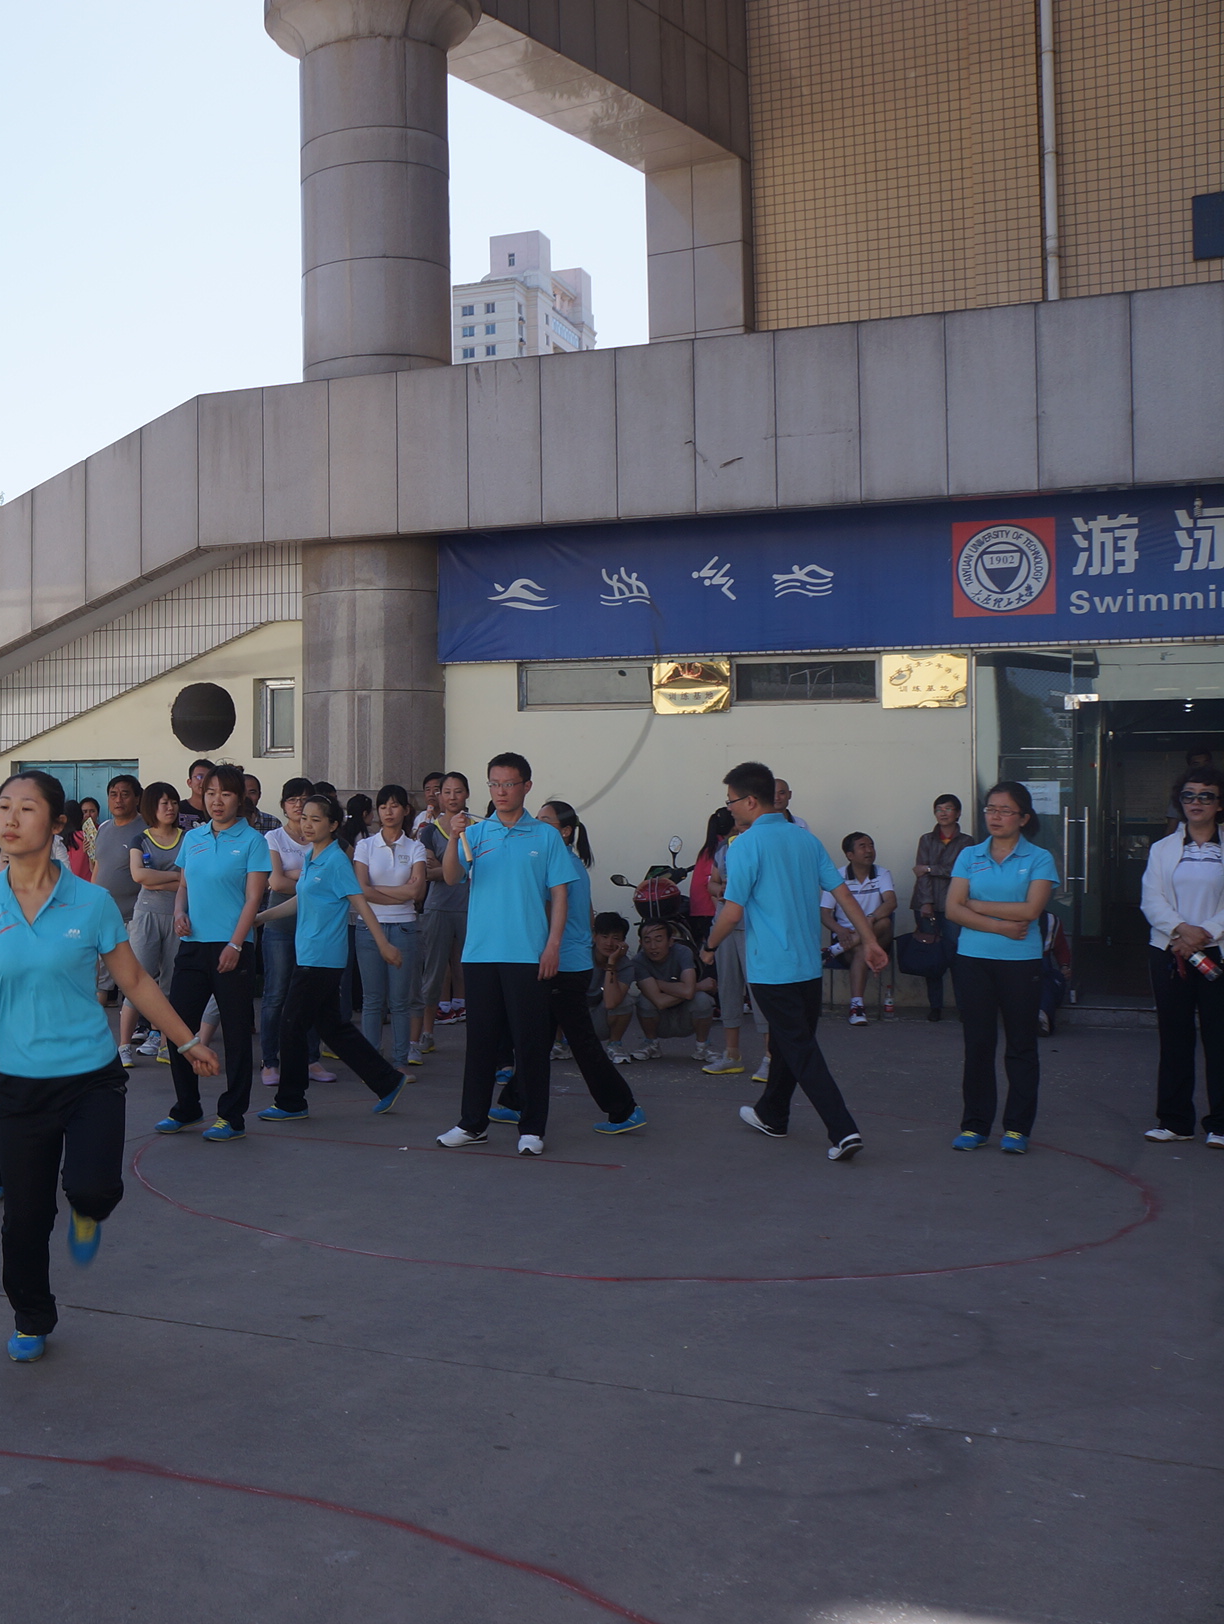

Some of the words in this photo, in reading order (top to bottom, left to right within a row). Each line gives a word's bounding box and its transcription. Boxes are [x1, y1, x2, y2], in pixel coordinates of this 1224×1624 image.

[961, 552, 974, 587] TAIYUAN
[968, 529, 1011, 553] UNIVERSITY
[1012, 531, 1024, 541] OF
[1022, 536, 1044, 583] TECHNOLOGY
[989, 555, 1015, 565] 1902
[1069, 584, 1224, 615] Swimmi
